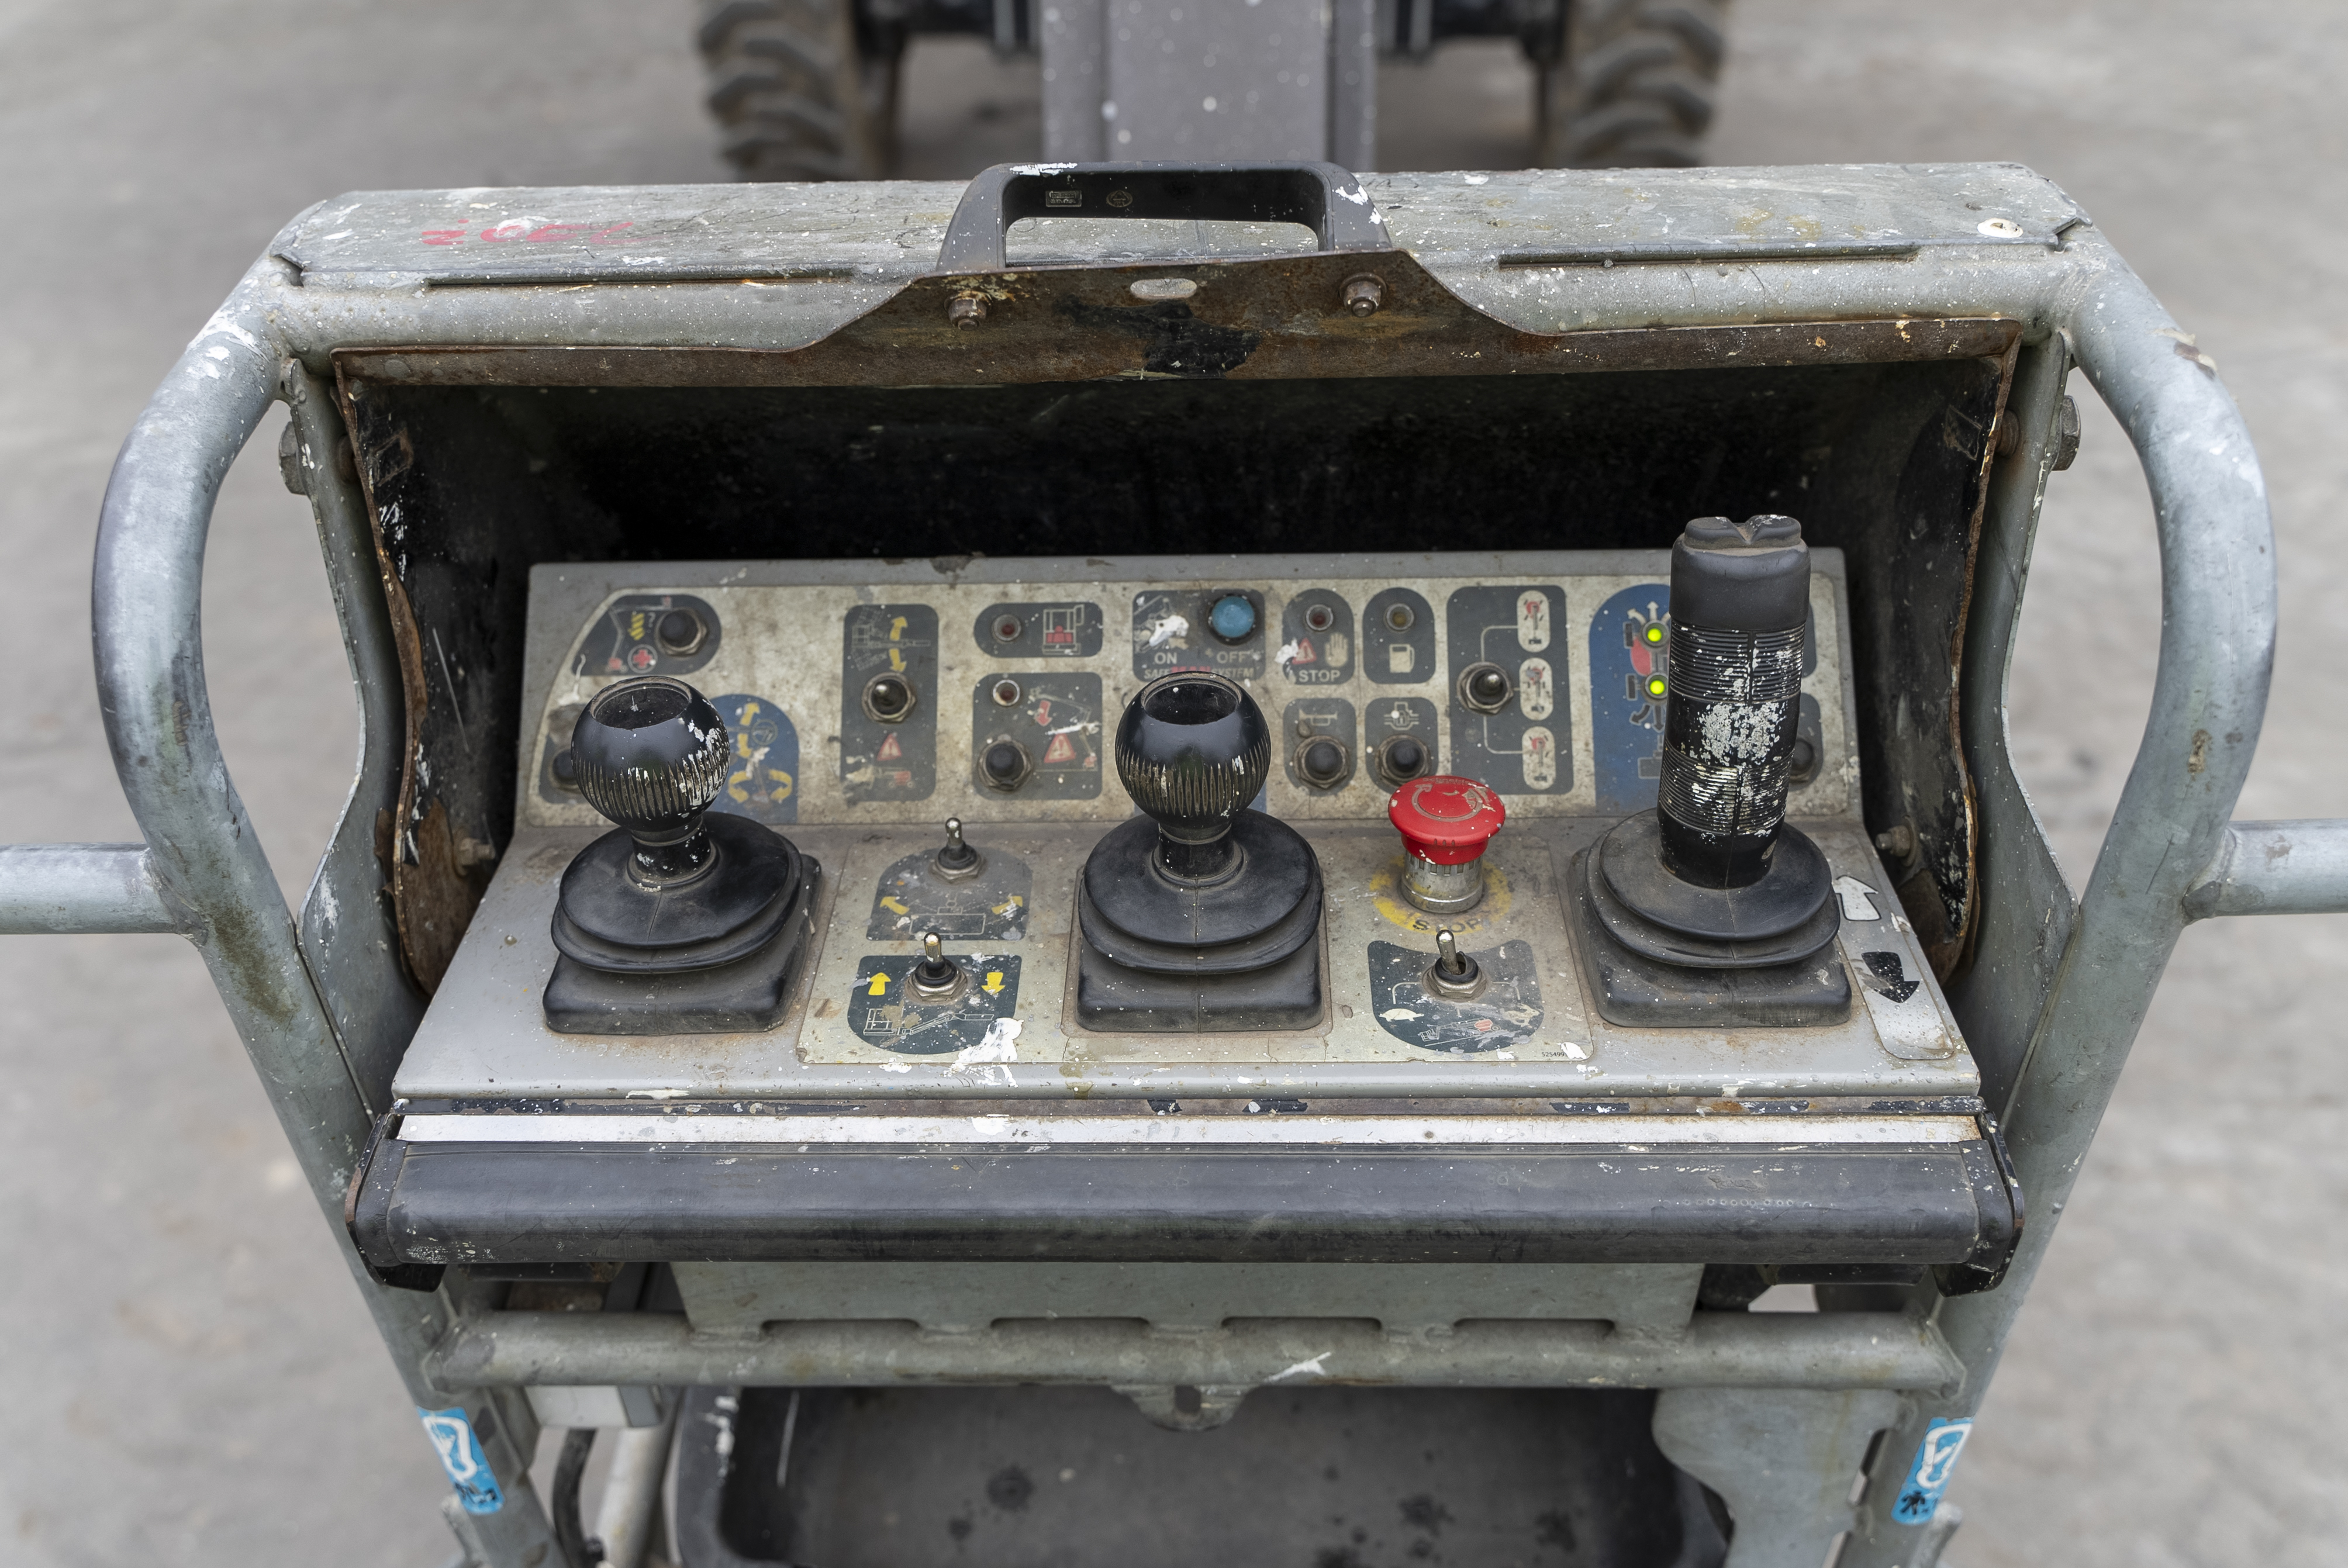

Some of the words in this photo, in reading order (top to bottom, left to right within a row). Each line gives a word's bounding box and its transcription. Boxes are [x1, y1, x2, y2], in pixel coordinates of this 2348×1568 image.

[1154, 652, 1178, 664] ON
[1217, 651, 1247, 664] OFF
[1299, 669, 1341, 682] STOP
